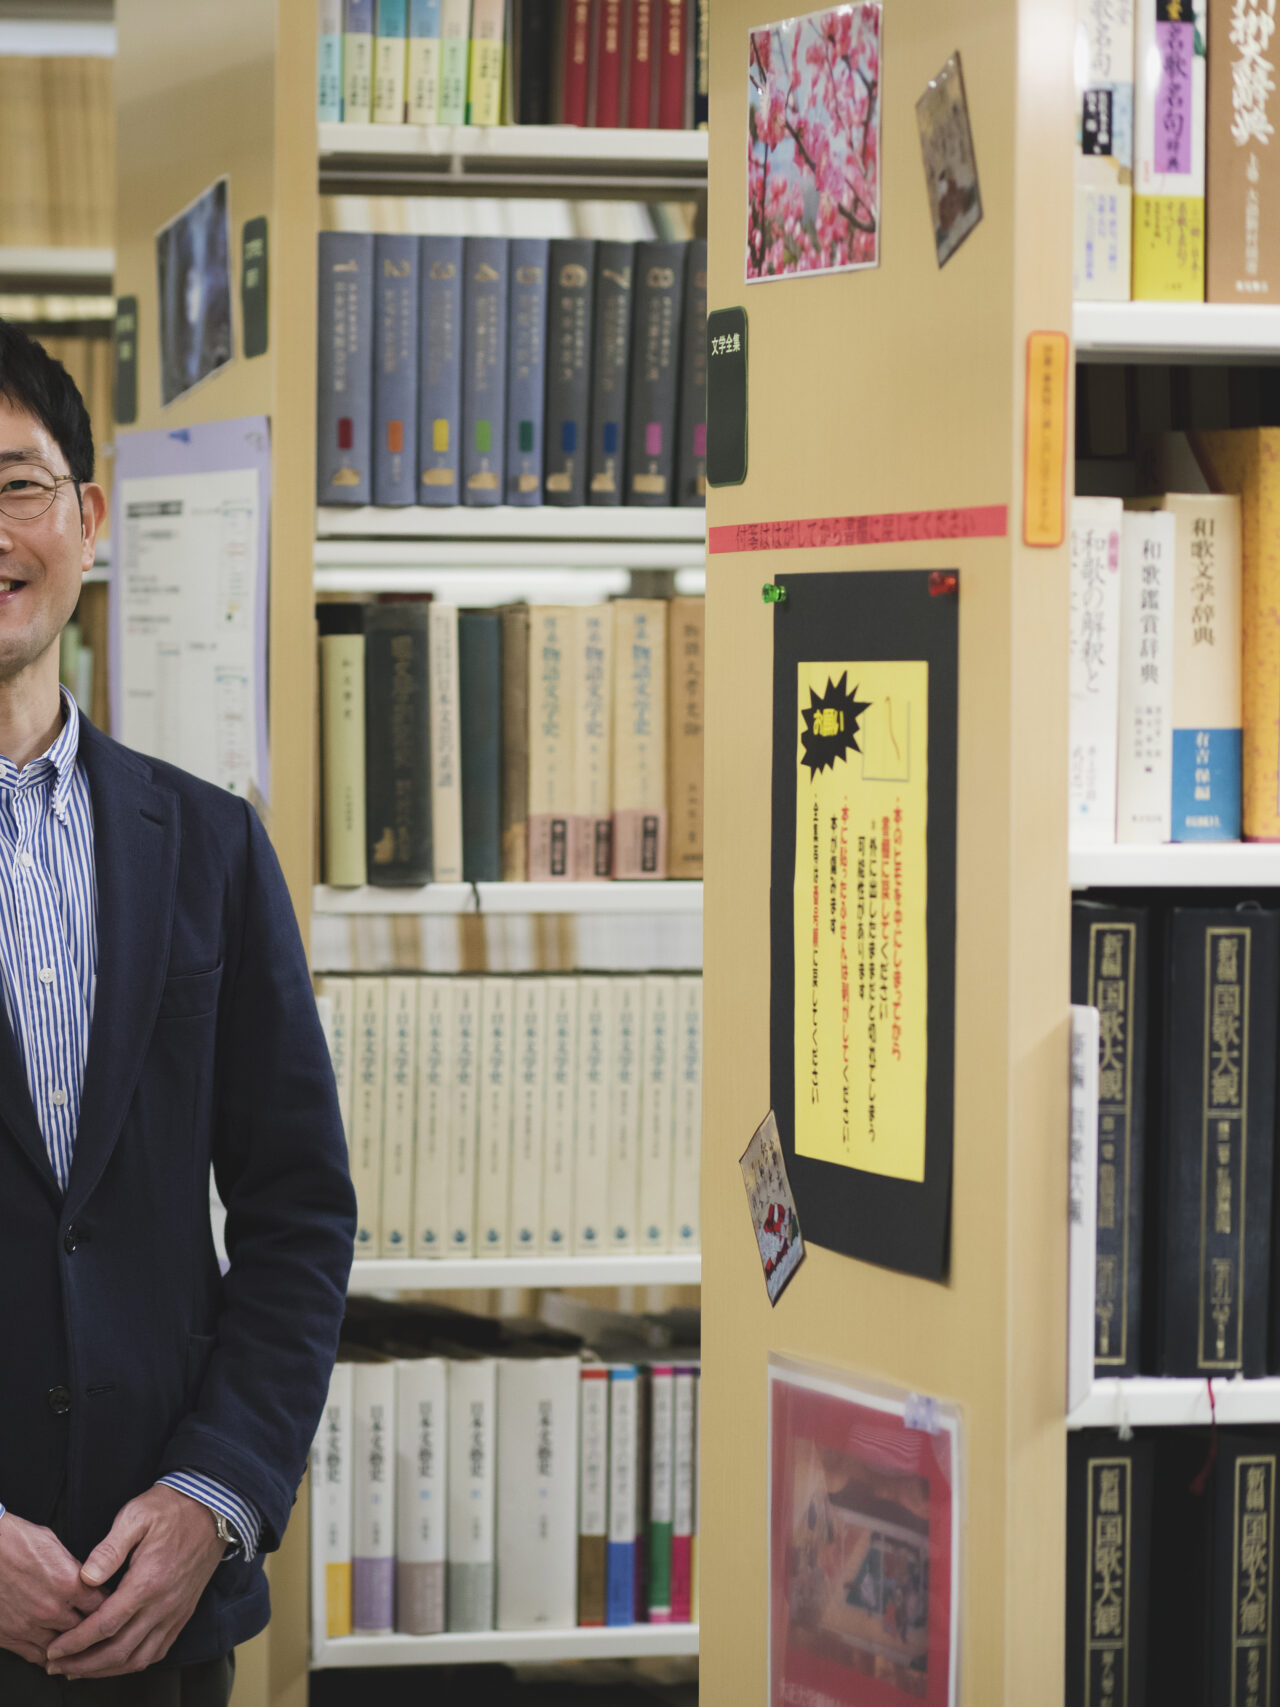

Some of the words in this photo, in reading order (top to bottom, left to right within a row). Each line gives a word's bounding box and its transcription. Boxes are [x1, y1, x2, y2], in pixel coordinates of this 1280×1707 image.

[383, 258, 410, 279] 2
[474, 262, 499, 283] 4
[559, 264, 587, 288] 6
[602, 266, 630, 290] 7
[647, 267, 675, 289] 8
[711, 333, 741, 356] 文学全集
[1190, 517, 1215, 646] 和歌文学辞典
[1080, 529, 1106, 694] 和歌の解釈と
[1140, 539, 1161, 684] 和歌鑑賞辞典
